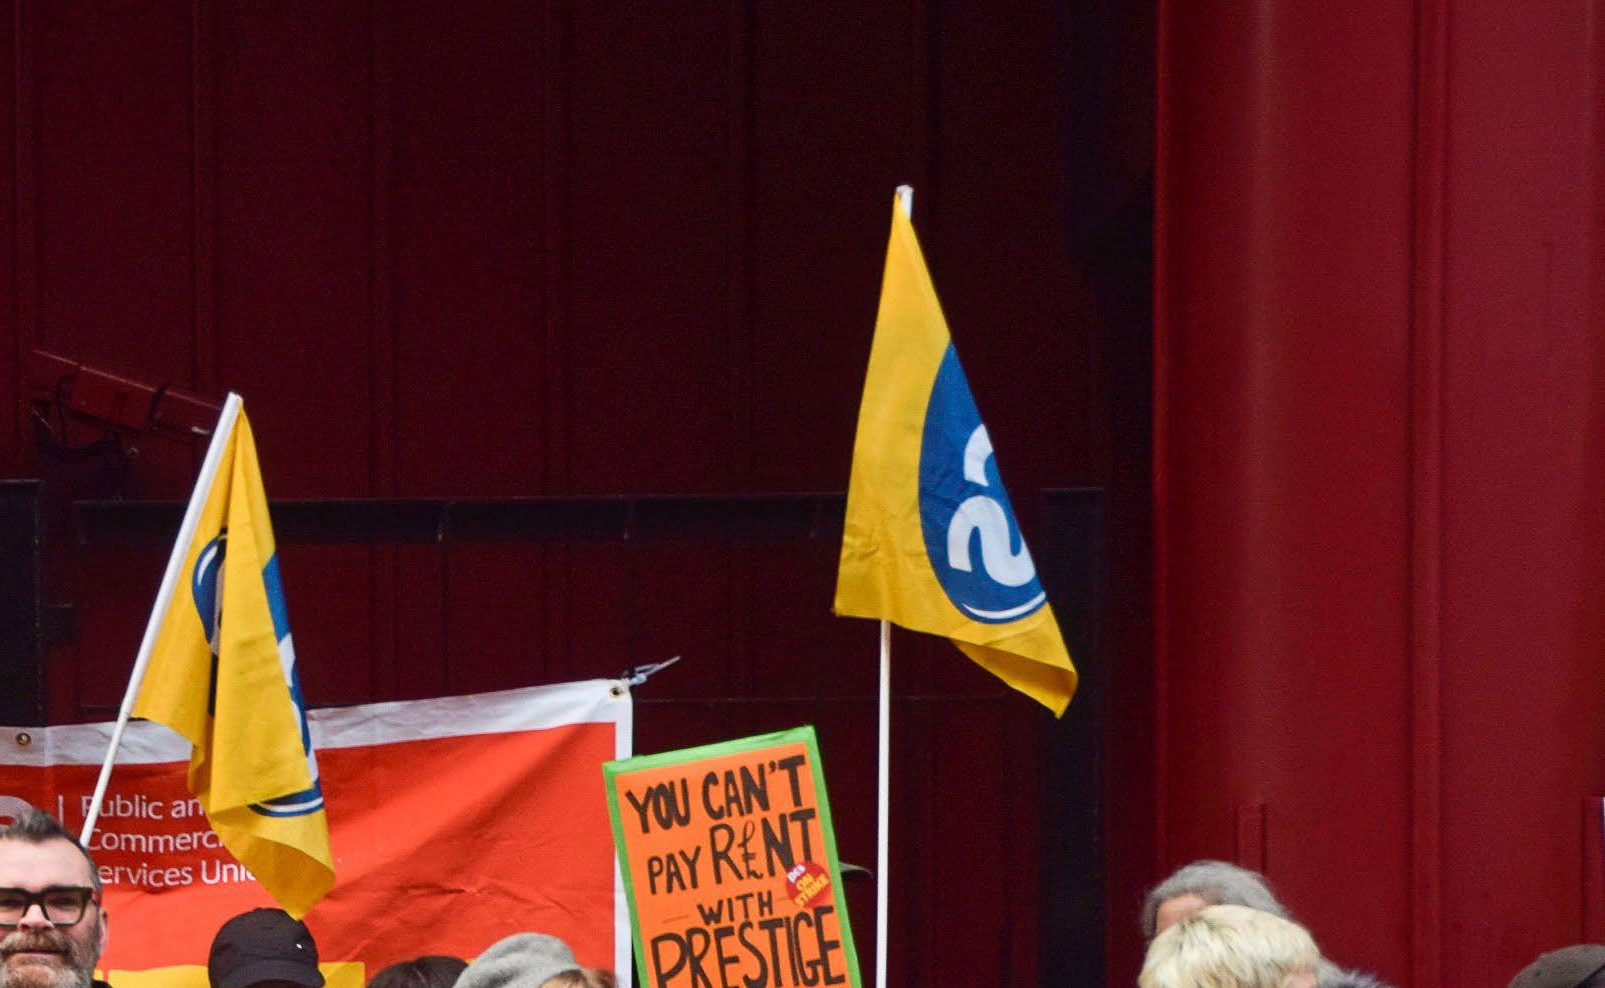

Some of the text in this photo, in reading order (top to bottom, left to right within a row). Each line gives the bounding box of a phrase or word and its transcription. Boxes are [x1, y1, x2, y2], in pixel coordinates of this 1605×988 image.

[171, 798, 205, 819] an
[625, 755, 805, 834] YOU CAN'T
[89, 829, 226, 854] Commerc
[97, 863, 193, 888] ervices
[647, 846, 702, 895] PAY
[697, 890, 774, 926] WITH
